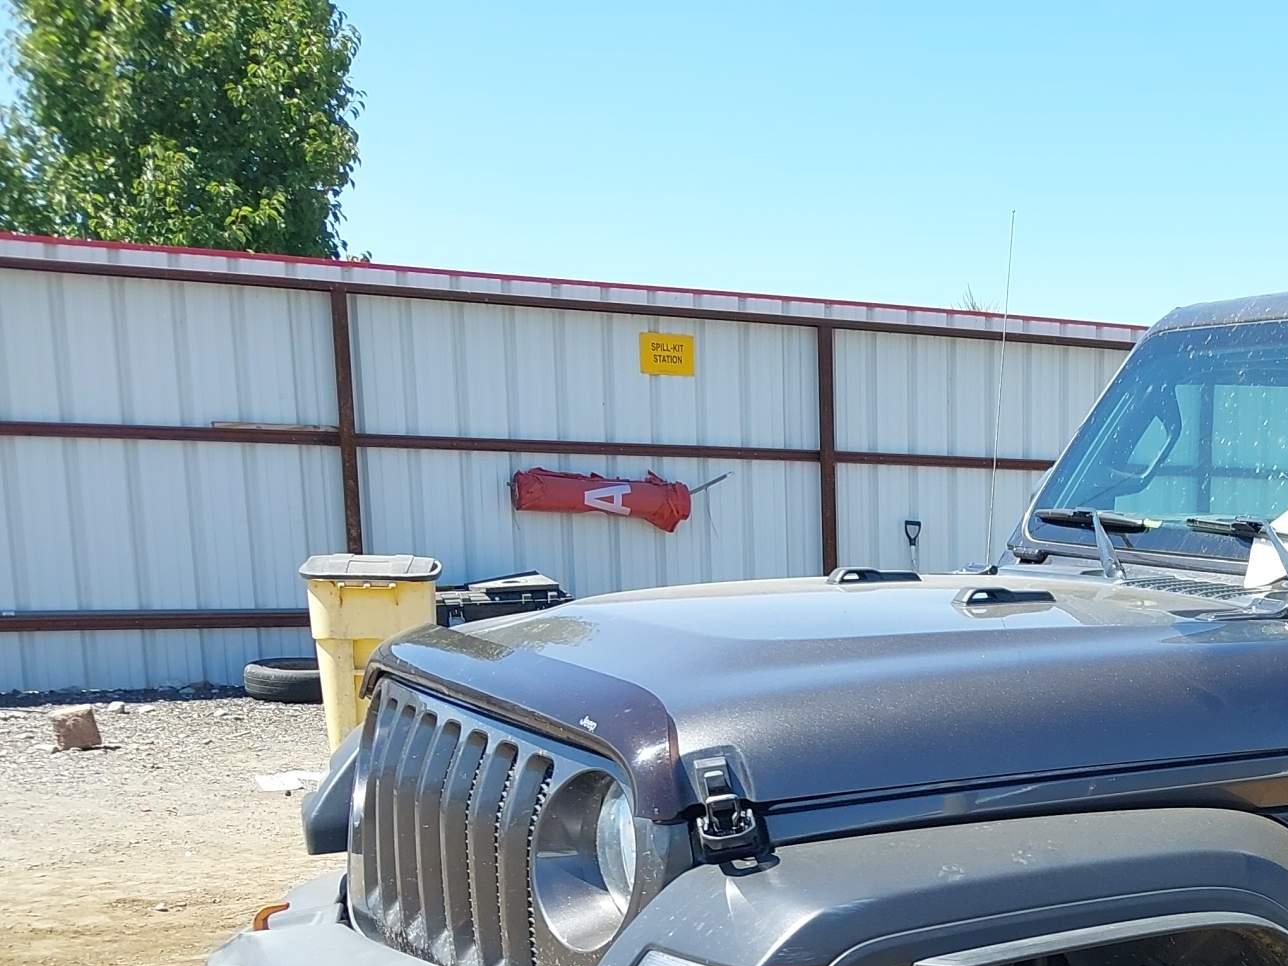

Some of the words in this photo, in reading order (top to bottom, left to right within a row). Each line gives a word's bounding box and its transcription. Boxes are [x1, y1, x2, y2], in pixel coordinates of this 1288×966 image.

[650, 342, 684, 353] SPILL-KIT
[653, 354, 683, 364] STATION
[584, 484, 631, 516] A
[579, 715, 597, 733] Jeep
